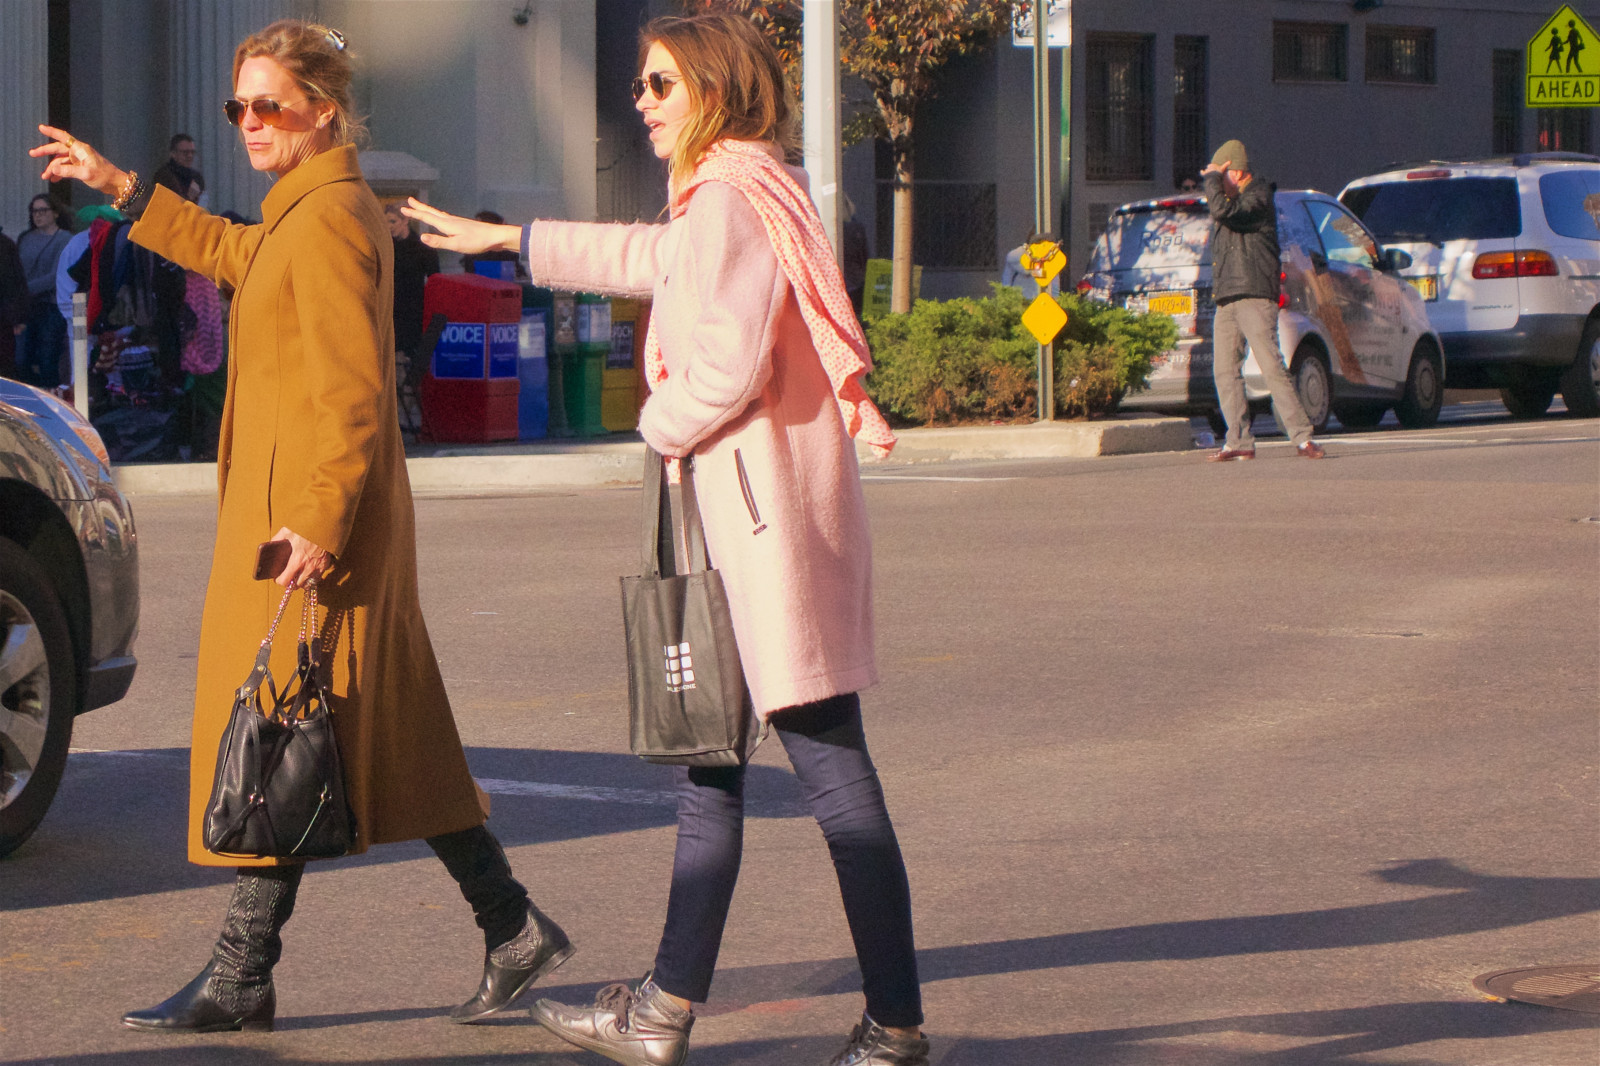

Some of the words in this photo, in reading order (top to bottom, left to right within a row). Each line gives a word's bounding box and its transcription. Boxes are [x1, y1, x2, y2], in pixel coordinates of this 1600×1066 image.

[1536, 80, 1594, 98] AHEAD
[1139, 231, 1184, 247] Road
[441, 325, 483, 343] VOICE
[490, 325, 518, 343] VOICE
